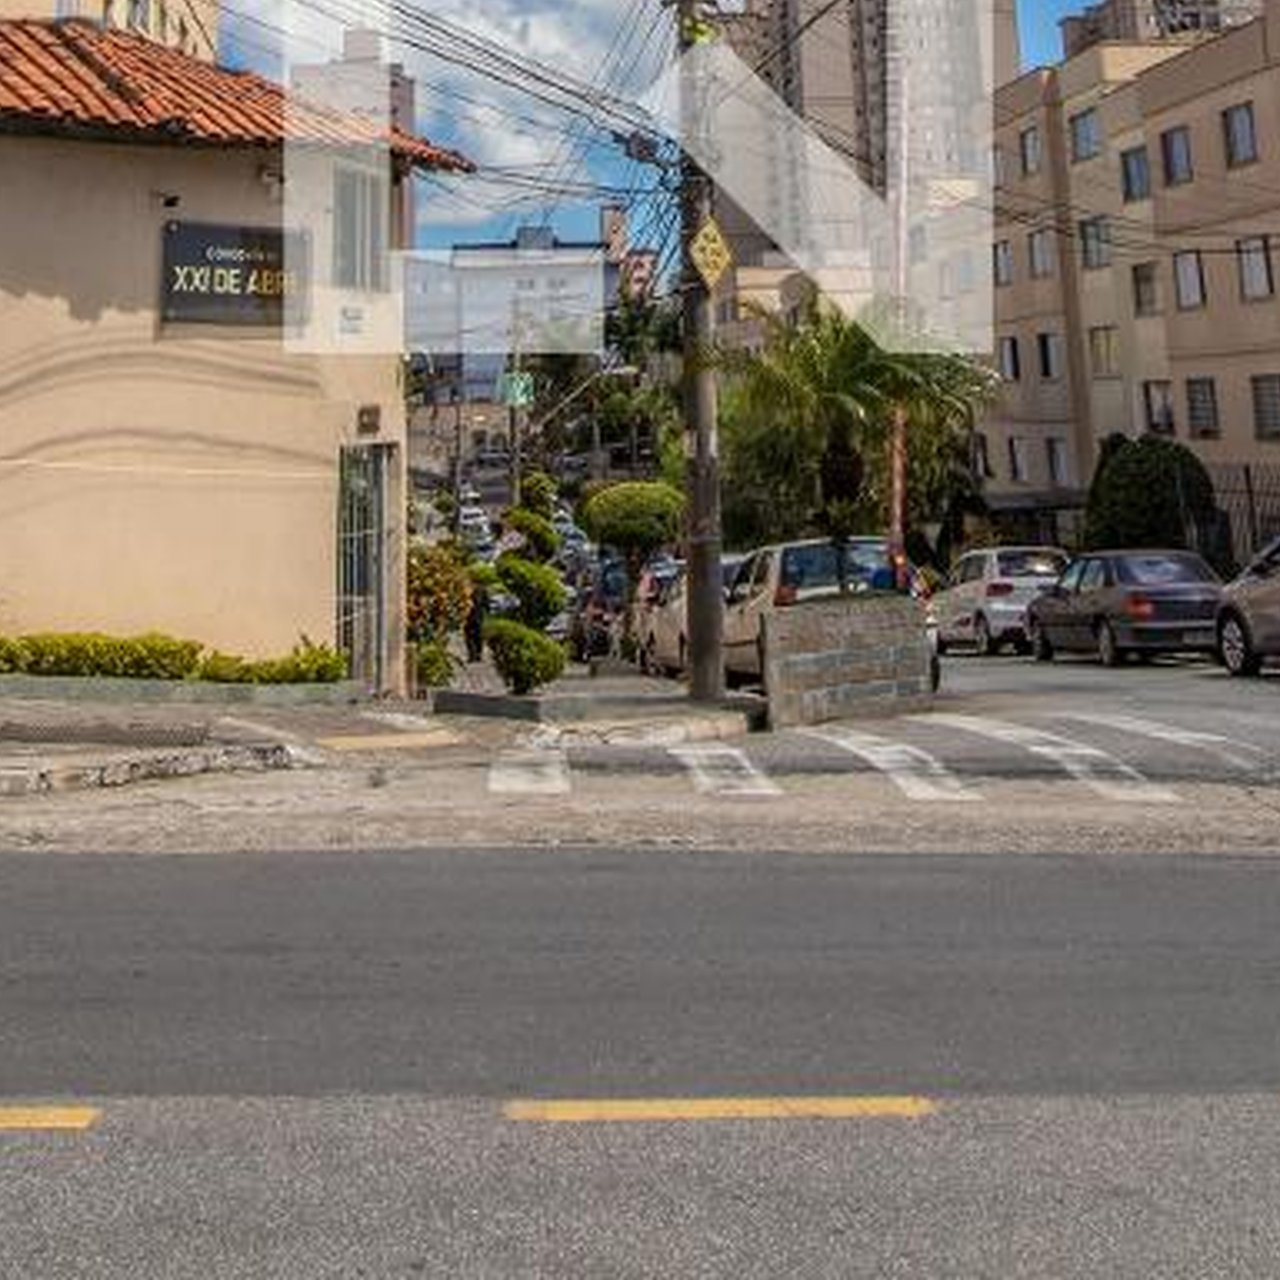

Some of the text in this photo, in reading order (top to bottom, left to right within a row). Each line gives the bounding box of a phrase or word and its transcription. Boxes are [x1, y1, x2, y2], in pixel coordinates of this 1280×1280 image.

[172, 265, 306, 296] XXI DE ABRI
